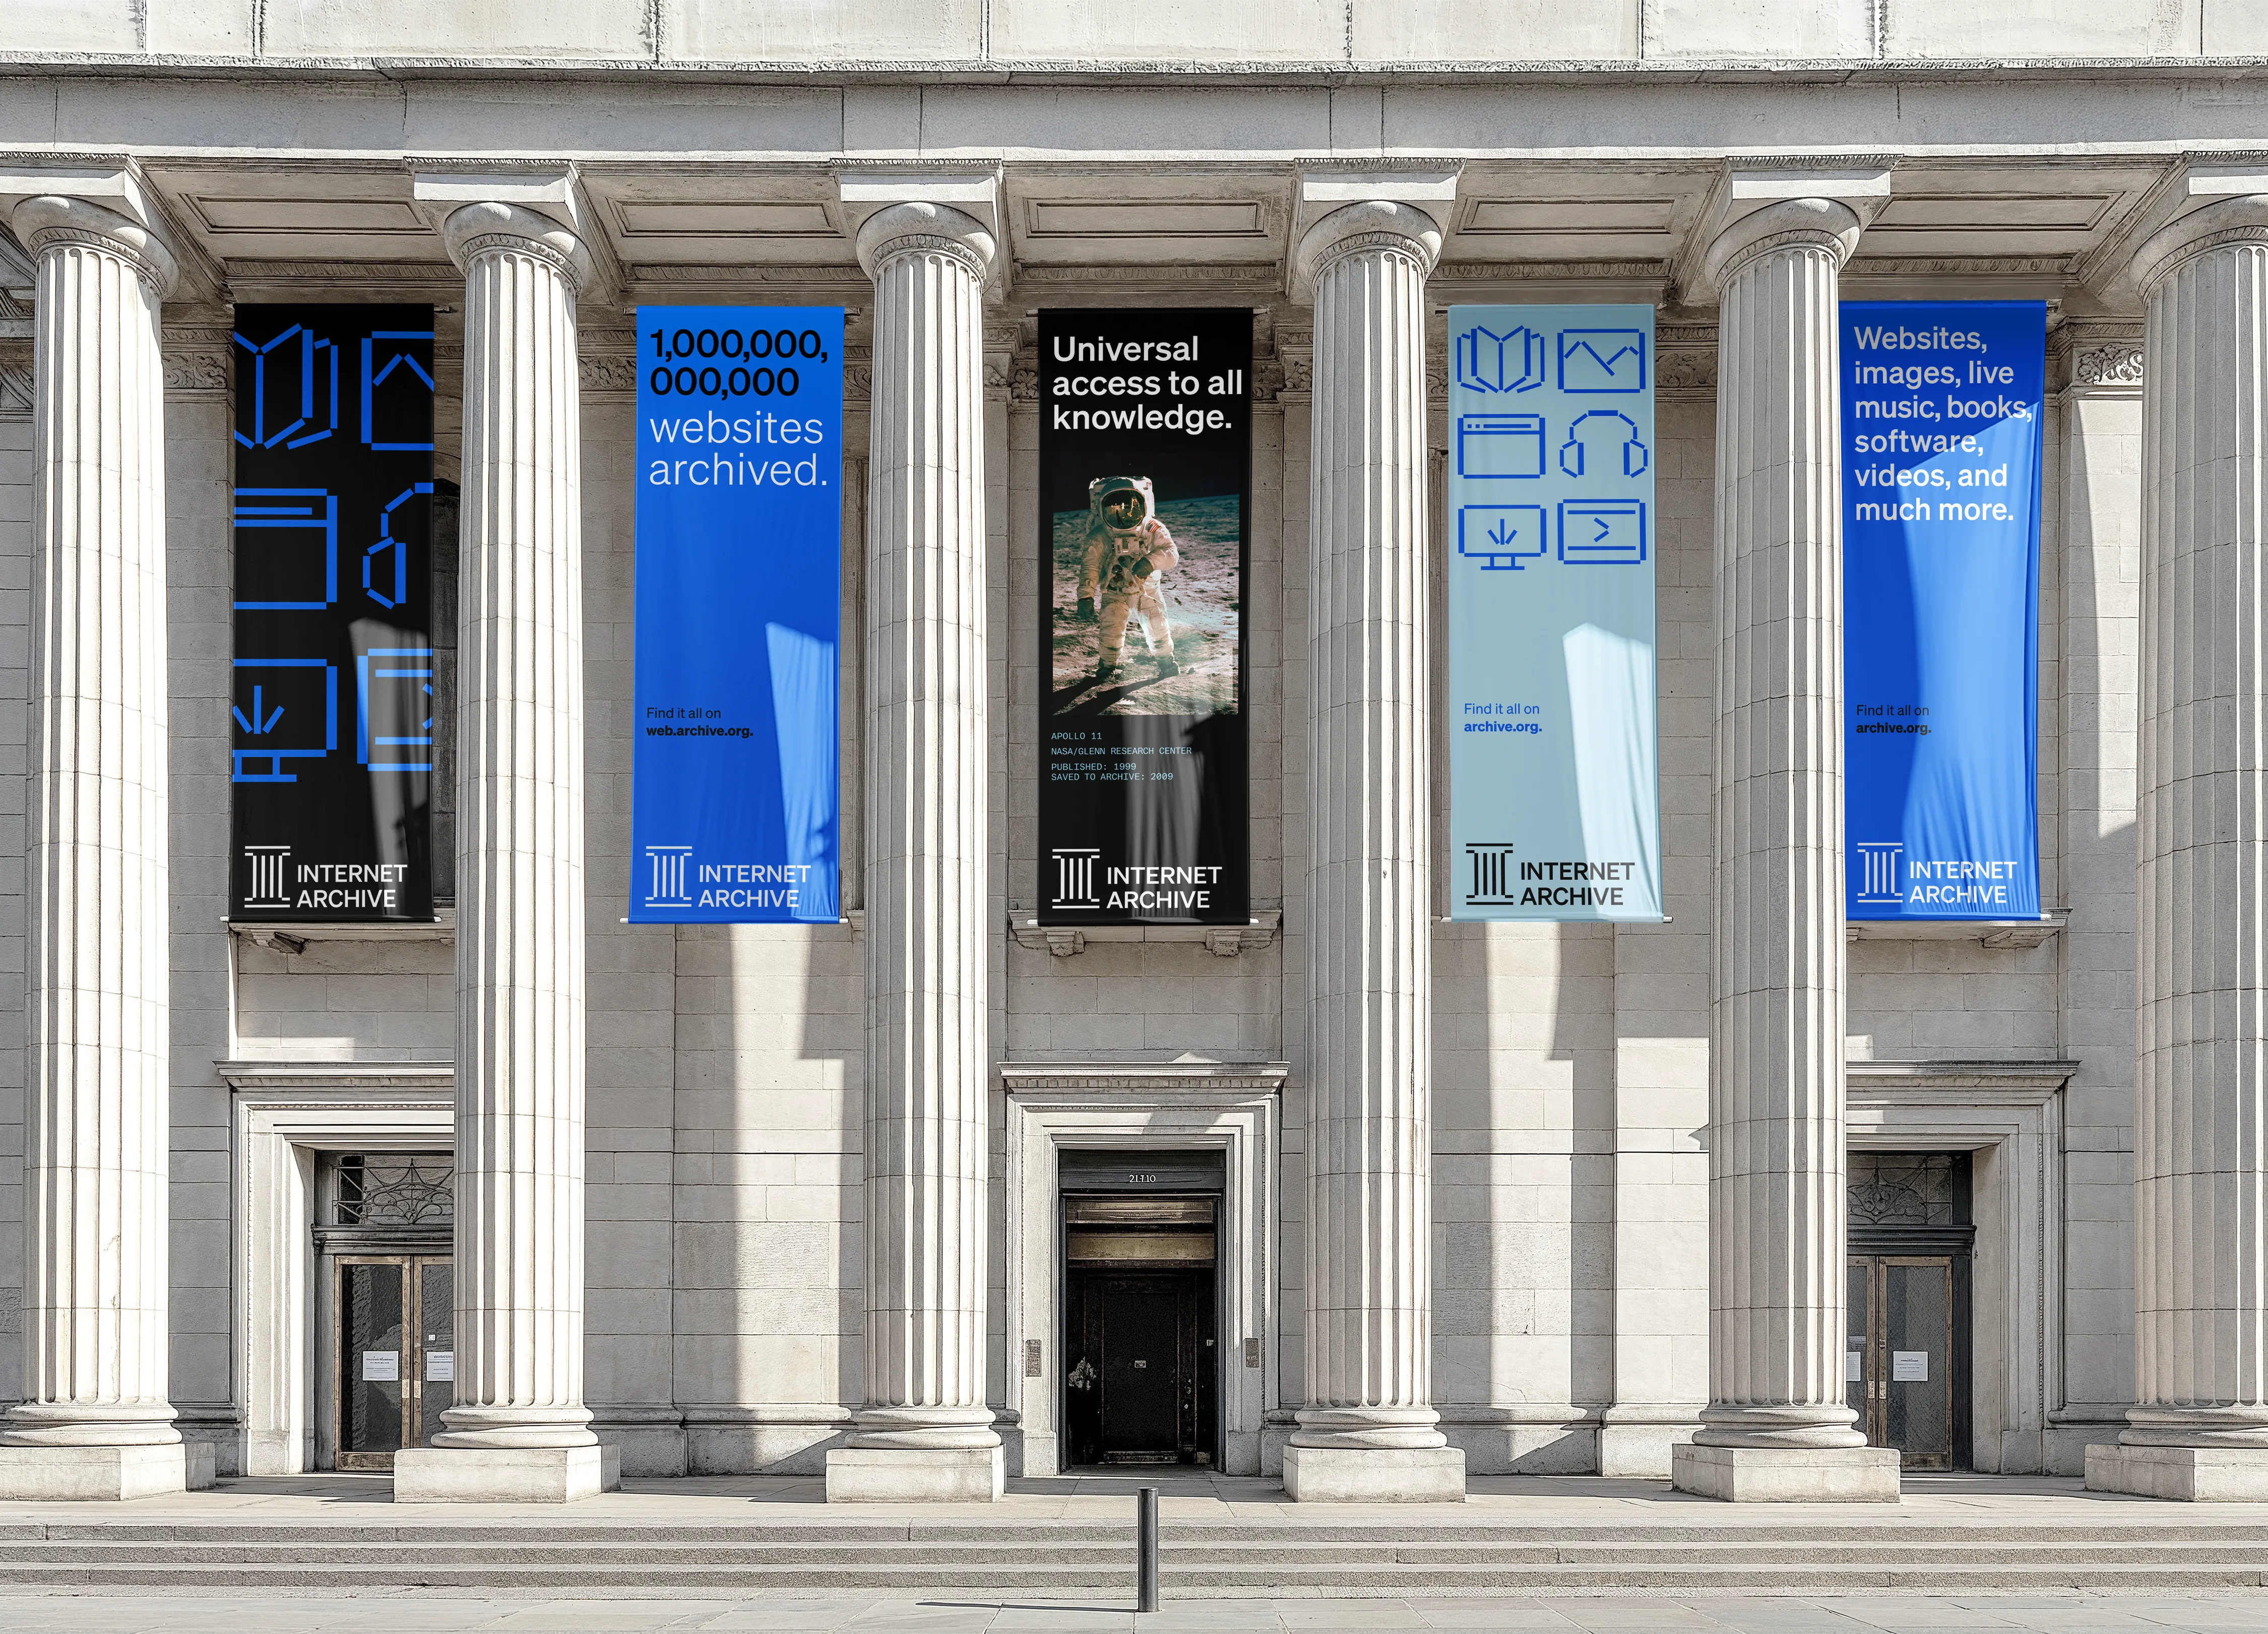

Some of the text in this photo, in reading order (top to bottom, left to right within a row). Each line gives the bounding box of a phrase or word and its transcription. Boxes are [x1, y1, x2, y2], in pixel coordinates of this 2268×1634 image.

[650, 328, 829, 363] 1,000,000,
[1053, 335, 1199, 362] Universal
[1854, 326, 1987, 354] Websites,
[650, 366, 799, 401] 000,000
[1052, 369, 1242, 396] access to all
[1855, 360, 2014, 389] images, live
[1855, 395, 2033, 423] music, books,
[649, 410, 823, 444] websites
[1053, 404, 1232, 435] knowledge.
[1854, 429, 1984, 456] software,
[649, 452, 827, 486] archived.
[1854, 463, 2007, 491] videos, and
[1855, 497, 2014, 521] much more.
[647, 707, 721, 718] Find it all on
[1464, 703, 1540, 715] Find it all on
[1856, 704, 1929, 716] Find it all on
[646, 725, 753, 739] web.archive.org.
[1051, 732, 1102, 740] APOLLO 11
[1464, 721, 1542, 735] archive.org.
[1856, 722, 1932, 736] archive.org.
[1051, 747, 1192, 757] NASA/GLENN RESEARCH CENTER
[1051, 762, 1137, 771] PUBLISHED: 1999
[1051, 773, 1080, 781] SAVED
[1100, 772, 1145, 780] ARCHIVE:
[1151, 772, 1174, 780] 2009
[297, 864, 408, 883] INTERNET
[699, 864, 811, 883] INTERNET
[1107, 866, 1222, 885] INTERNET
[1521, 862, 1635, 880] INTERNET
[1910, 861, 2018, 879] INTERNET
[296, 889, 396, 908] ARCHIVE
[698, 889, 799, 908] ARCHIVE
[1106, 890, 1210, 909] ARCHIVE
[1520, 886, 1623, 906] ARCHIVE
[1909, 885, 2006, 903] ARCHIVE
